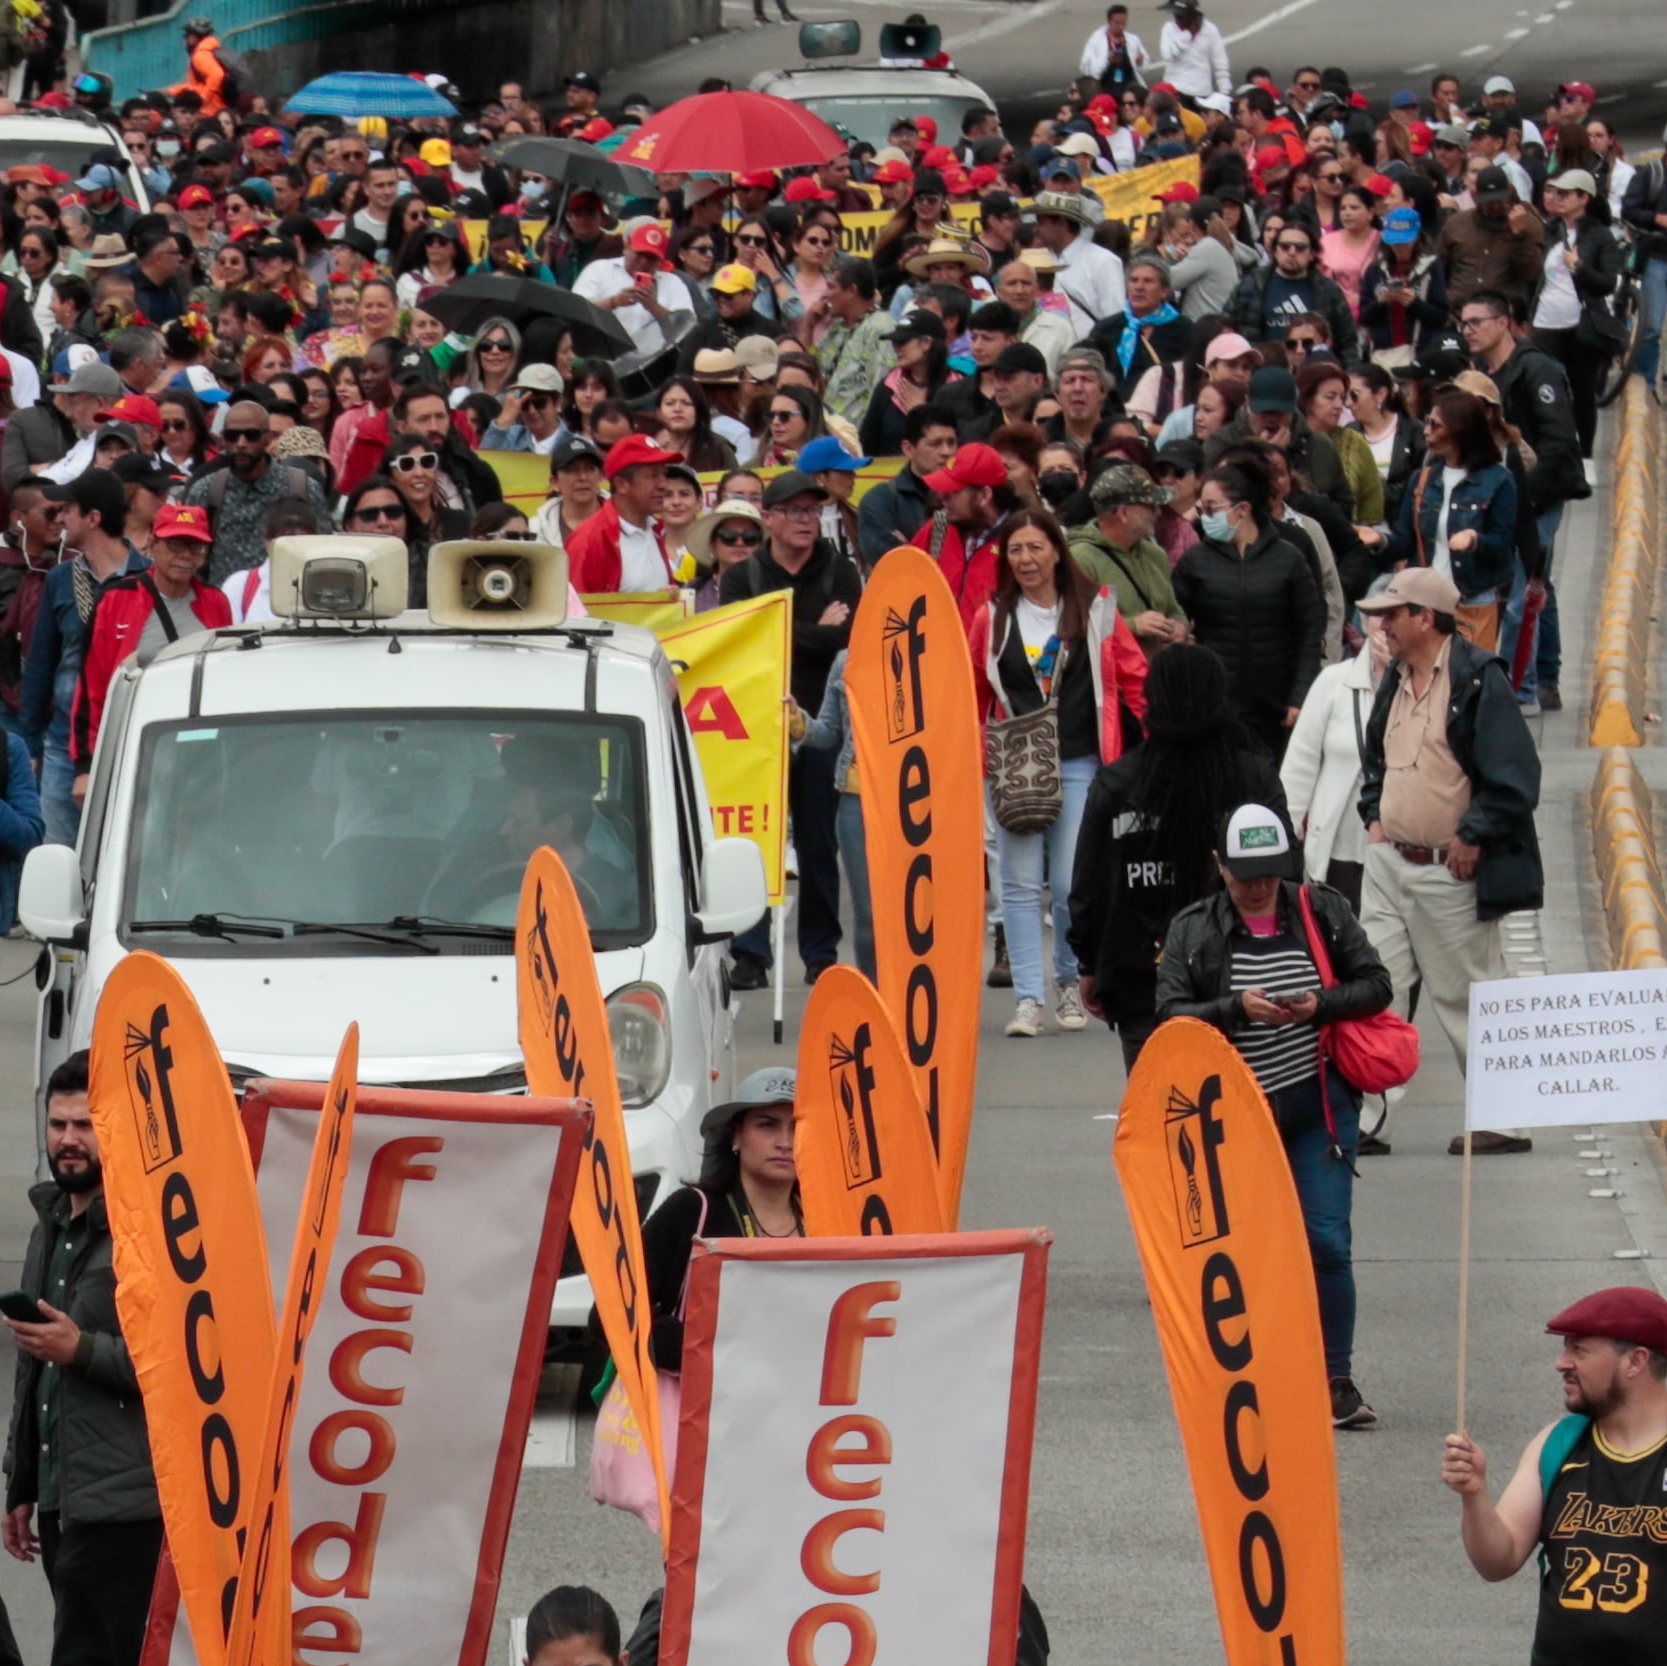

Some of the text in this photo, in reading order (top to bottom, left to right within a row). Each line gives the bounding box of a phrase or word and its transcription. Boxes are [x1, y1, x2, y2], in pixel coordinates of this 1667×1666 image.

[898, 594, 940, 1165] feco
[1479, 989, 1667, 1017] NO ES PARA EVALUA
[1480, 1030, 1493, 1044] A
[1498, 1026, 1529, 1042] LOS
[1484, 1046, 1656, 1072] PARA MANDARLOS
[1537, 1077, 1619, 1096] CALLAR.
[1558, 1547, 1648, 1613] 23
